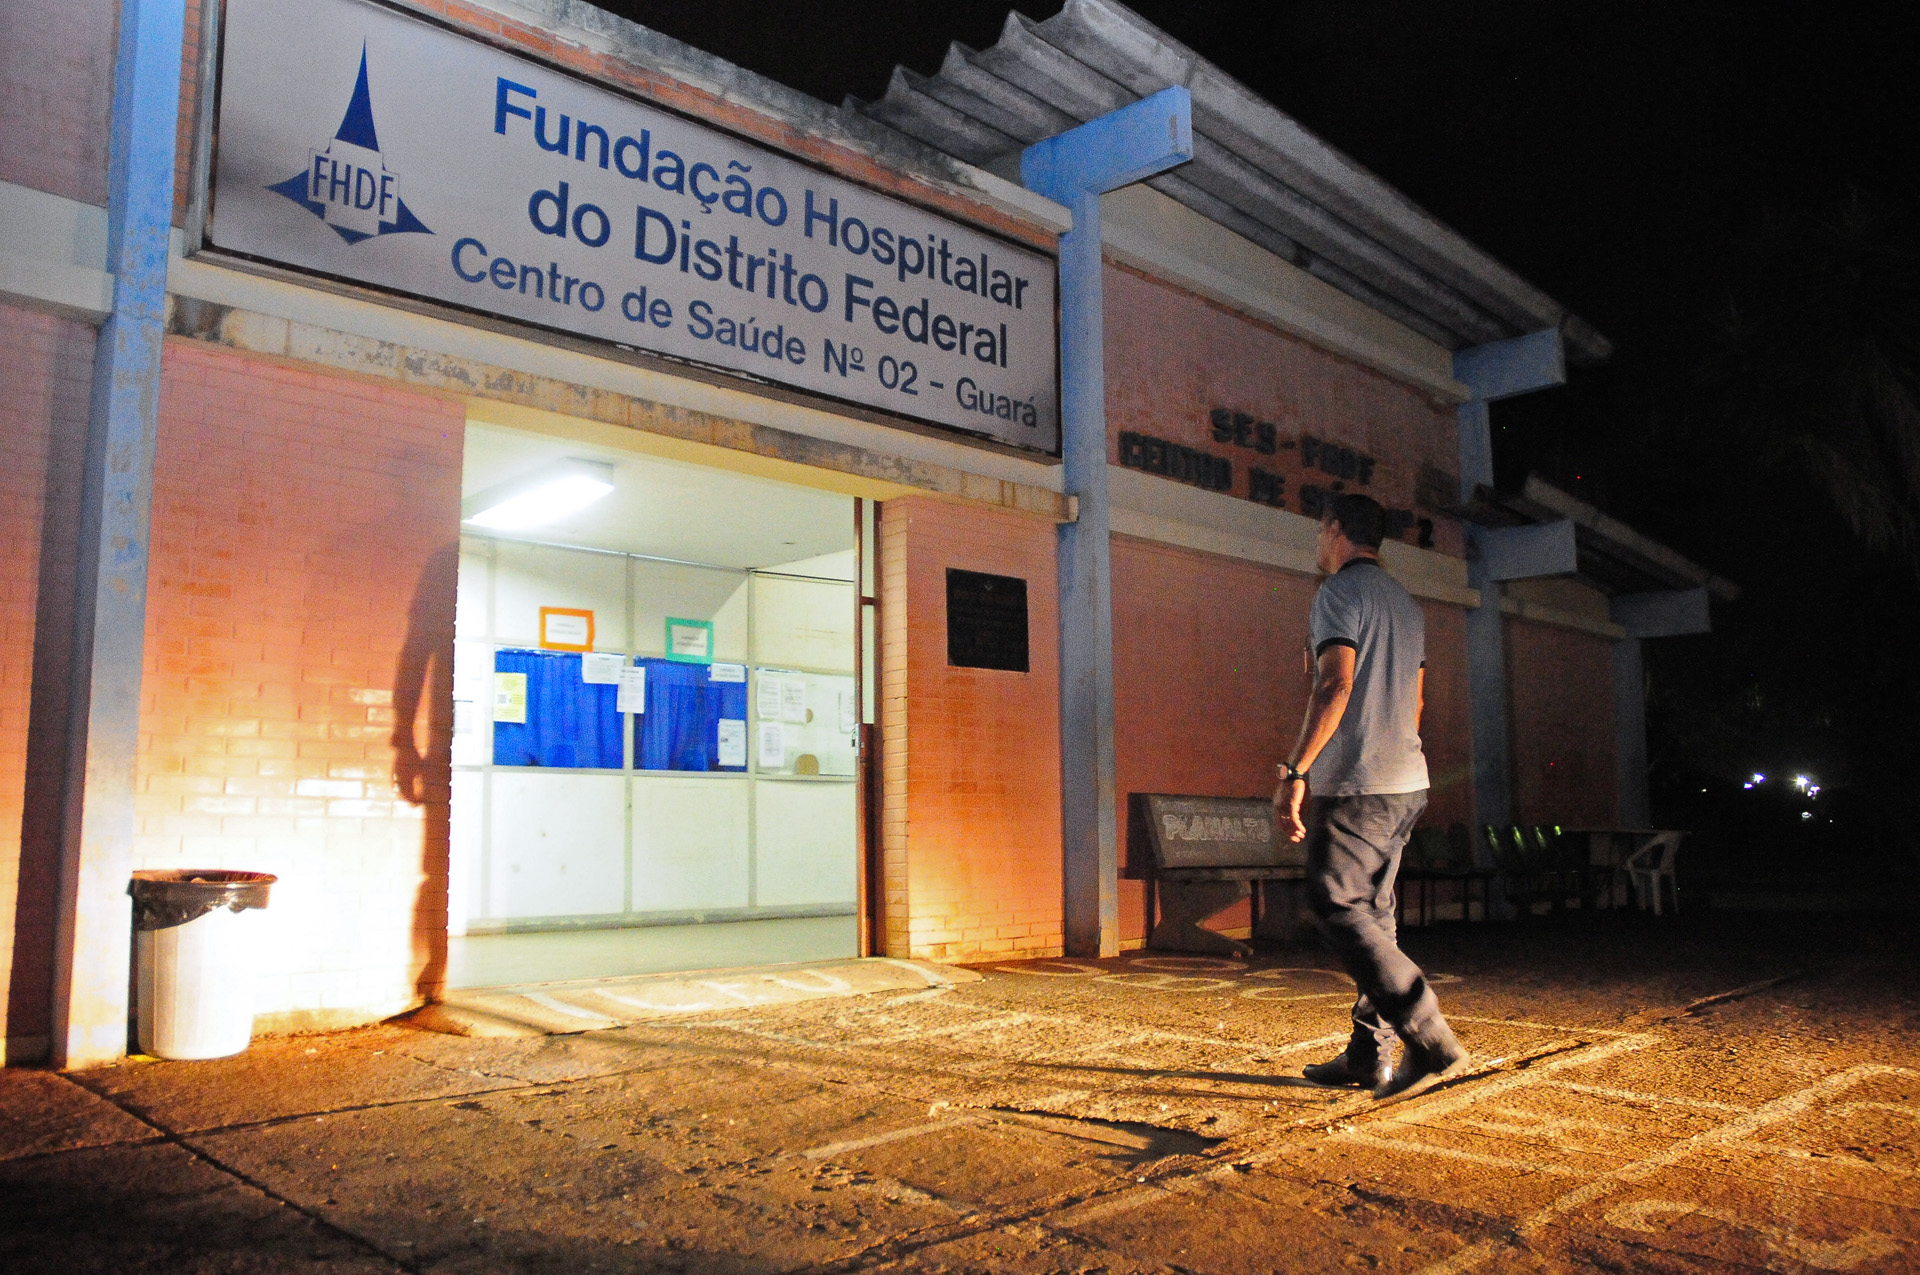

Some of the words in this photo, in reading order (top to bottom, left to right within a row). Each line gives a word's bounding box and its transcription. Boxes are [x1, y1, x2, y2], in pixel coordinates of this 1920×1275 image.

[312, 154, 395, 216] FHDF
[494, 77, 787, 226] Fundação
[804, 190, 1029, 310] Hospitalar
[528, 181, 611, 248] do
[634, 205, 829, 313] Distrito
[845, 273, 1008, 368] Federal
[451, 237, 605, 312] Centro
[621, 286, 673, 328] de
[687, 299, 806, 364] Saúde
[878, 355, 919, 396] 02
[955, 377, 1038, 428] Guará
